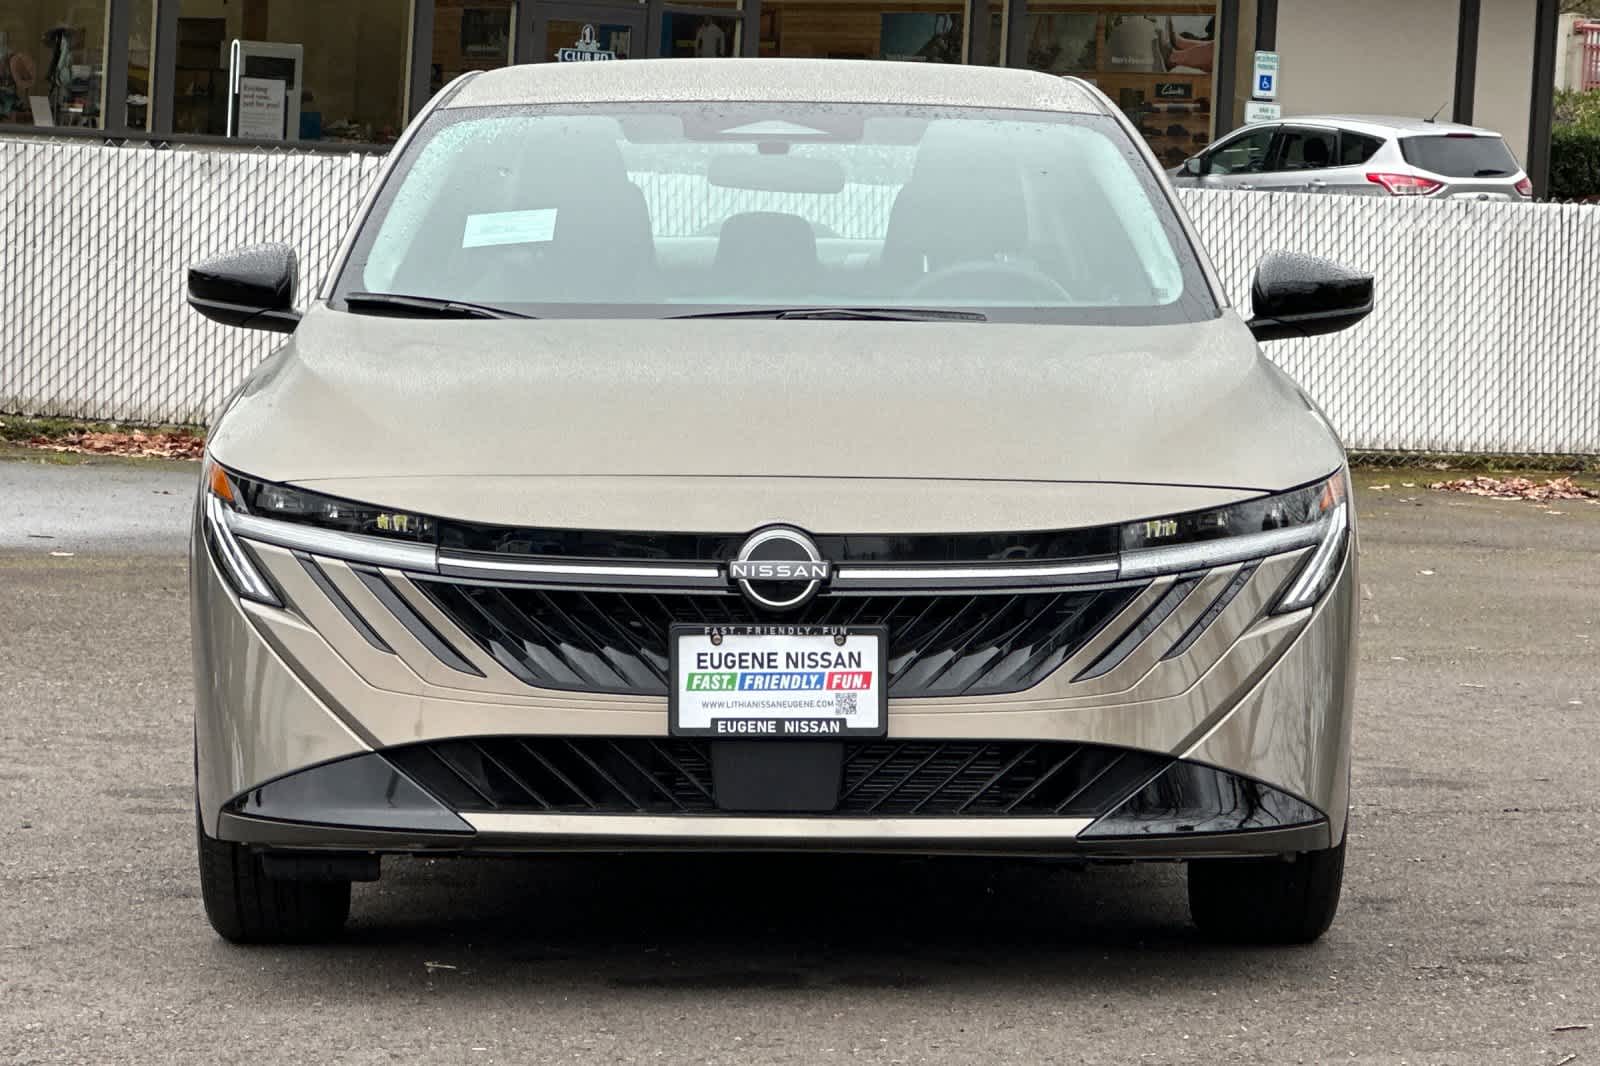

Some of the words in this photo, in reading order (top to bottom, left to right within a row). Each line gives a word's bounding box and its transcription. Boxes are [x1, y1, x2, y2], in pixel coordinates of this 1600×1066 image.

[564, 51, 592, 61] CLUB
[732, 564, 827, 577] NISSAN
[696, 652, 778, 670] EUGENE
[785, 651, 861, 669] NISSAN
[691, 674, 733, 690] FAST.
[743, 674, 821, 690] FRIENDLY.
[831, 674, 868, 689] FUN.
[701, 700, 835, 709] WWW.LITHIANISSANEUGENE.COM
[717, 720, 777, 733] EUGENE
[784, 720, 840, 733] NISSAN
